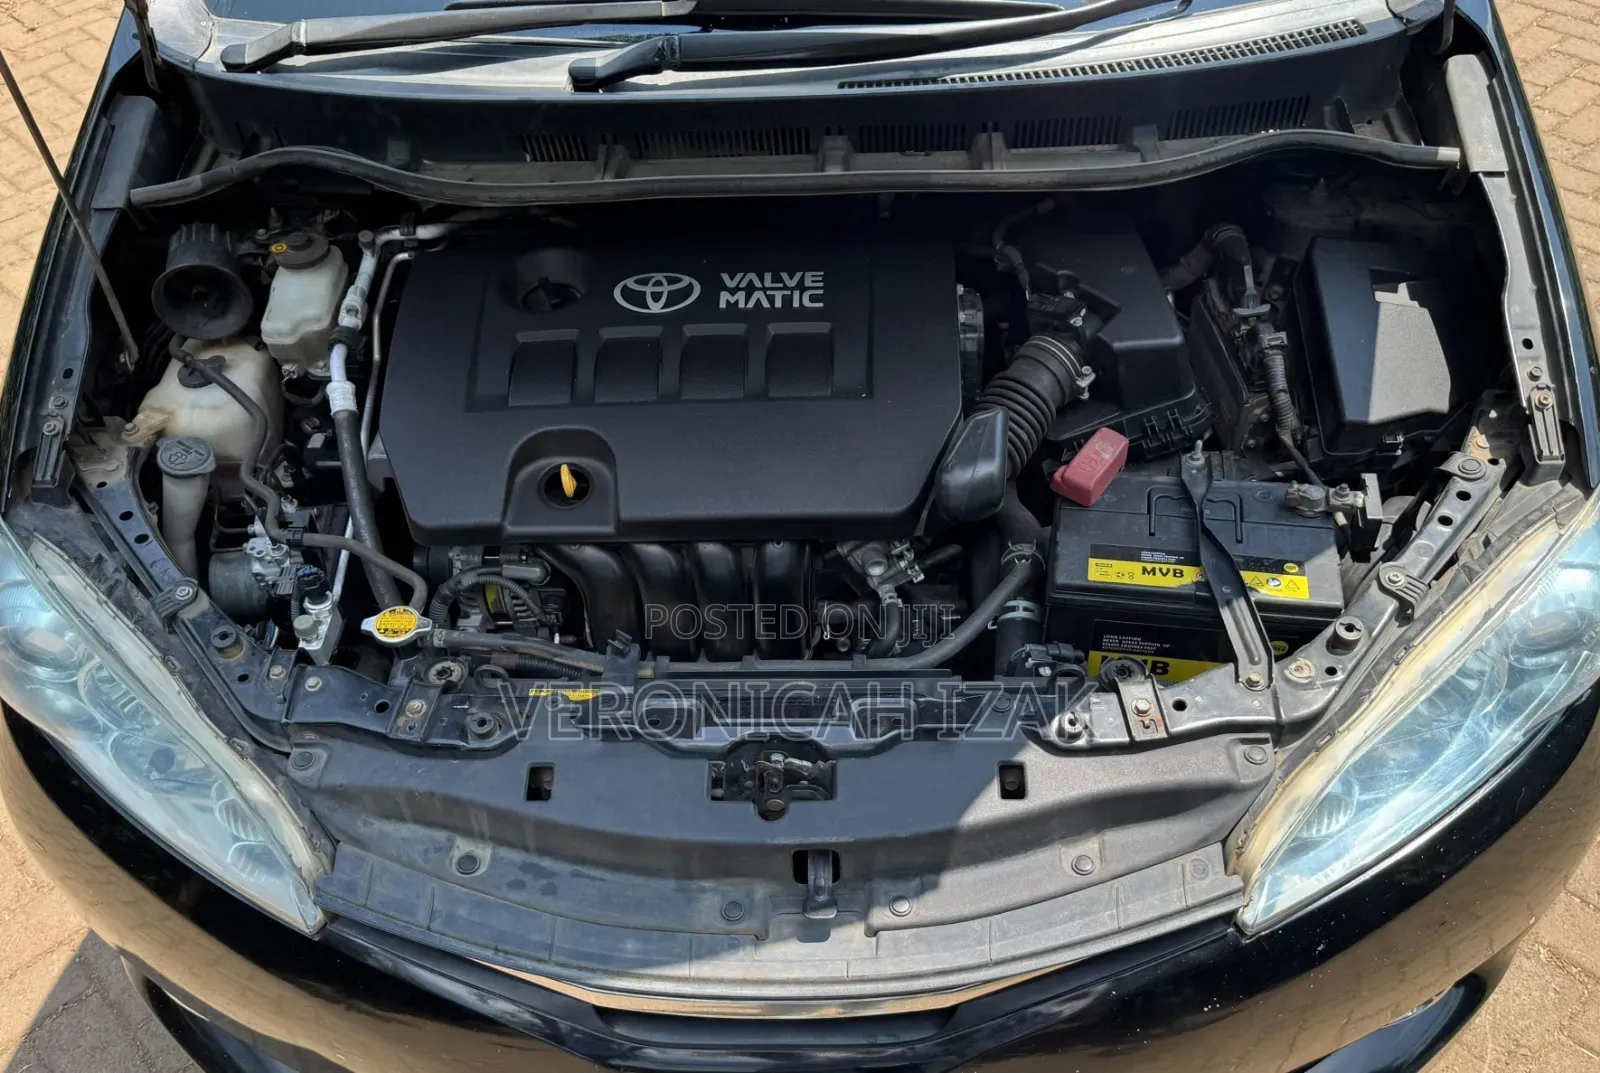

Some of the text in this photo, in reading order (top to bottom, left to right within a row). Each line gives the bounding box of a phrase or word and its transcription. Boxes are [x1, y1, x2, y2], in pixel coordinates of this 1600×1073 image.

[719, 271, 824, 288] VALVE
[719, 289, 824, 309] MATIC
[1141, 565, 1184, 578] MVB
